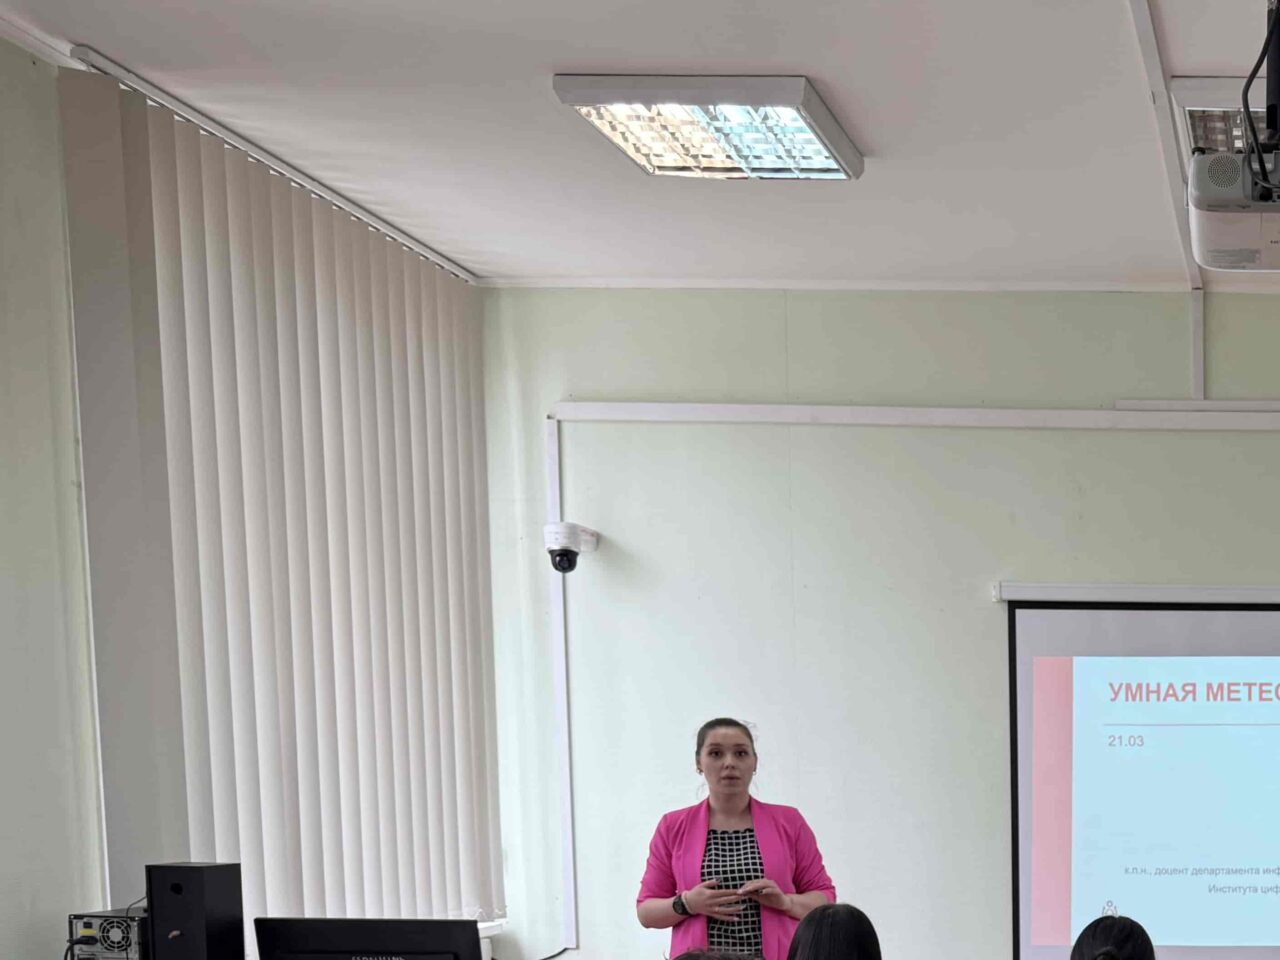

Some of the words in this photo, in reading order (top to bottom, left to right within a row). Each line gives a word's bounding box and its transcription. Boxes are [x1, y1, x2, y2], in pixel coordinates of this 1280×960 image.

[1108, 682, 1197, 702] УМНАЯ
[1108, 735, 1145, 747] 21.03
[1154, 867, 1189, 876] доцент
[1191, 867, 1260, 877] департамента
[1208, 884, 1258, 895] Института
